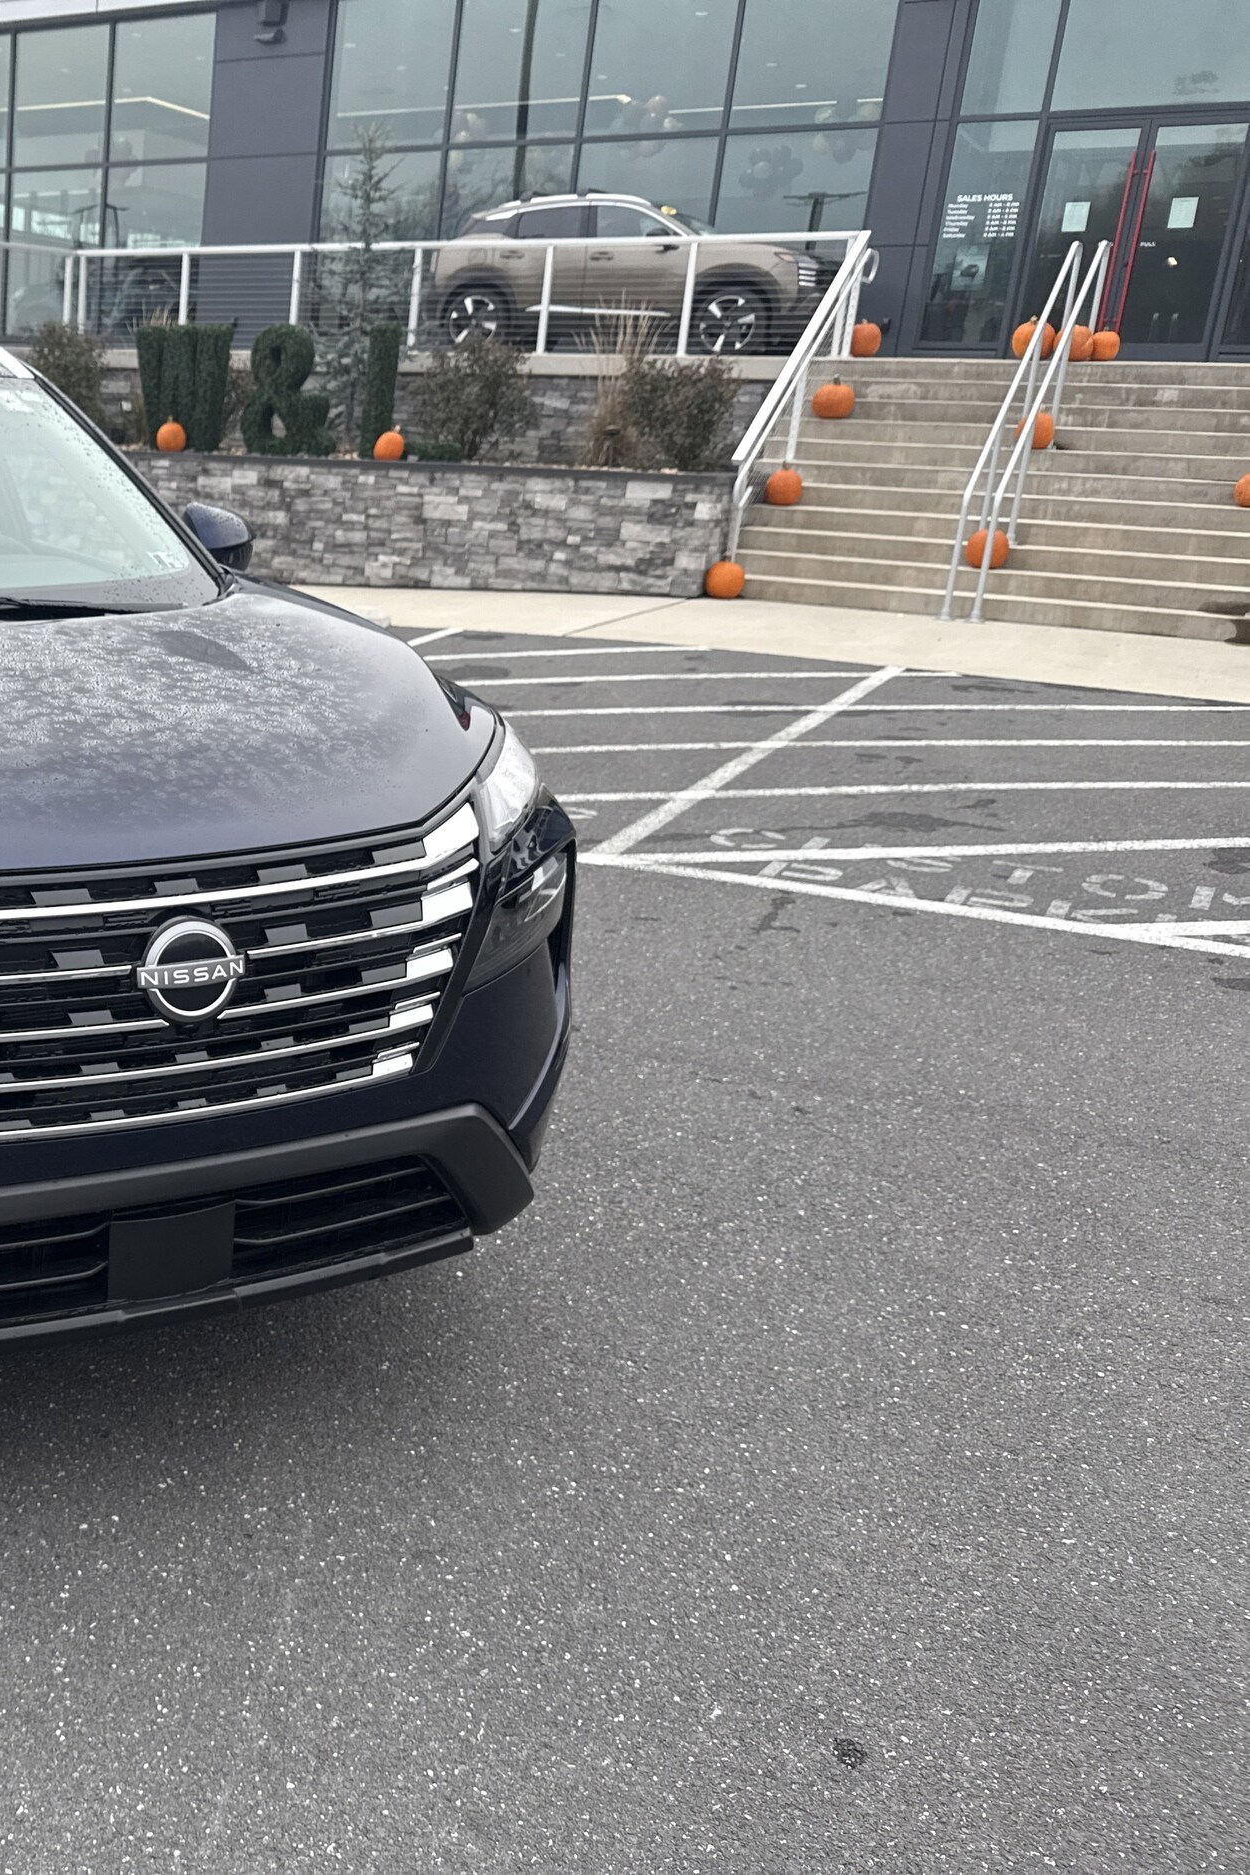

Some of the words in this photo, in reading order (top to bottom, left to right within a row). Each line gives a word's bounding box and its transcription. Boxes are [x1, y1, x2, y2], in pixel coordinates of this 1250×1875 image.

[957, 194, 982, 202] SALES
[984, 193, 1013, 201] HOURS
[140, 959, 244, 986] NISSAN
